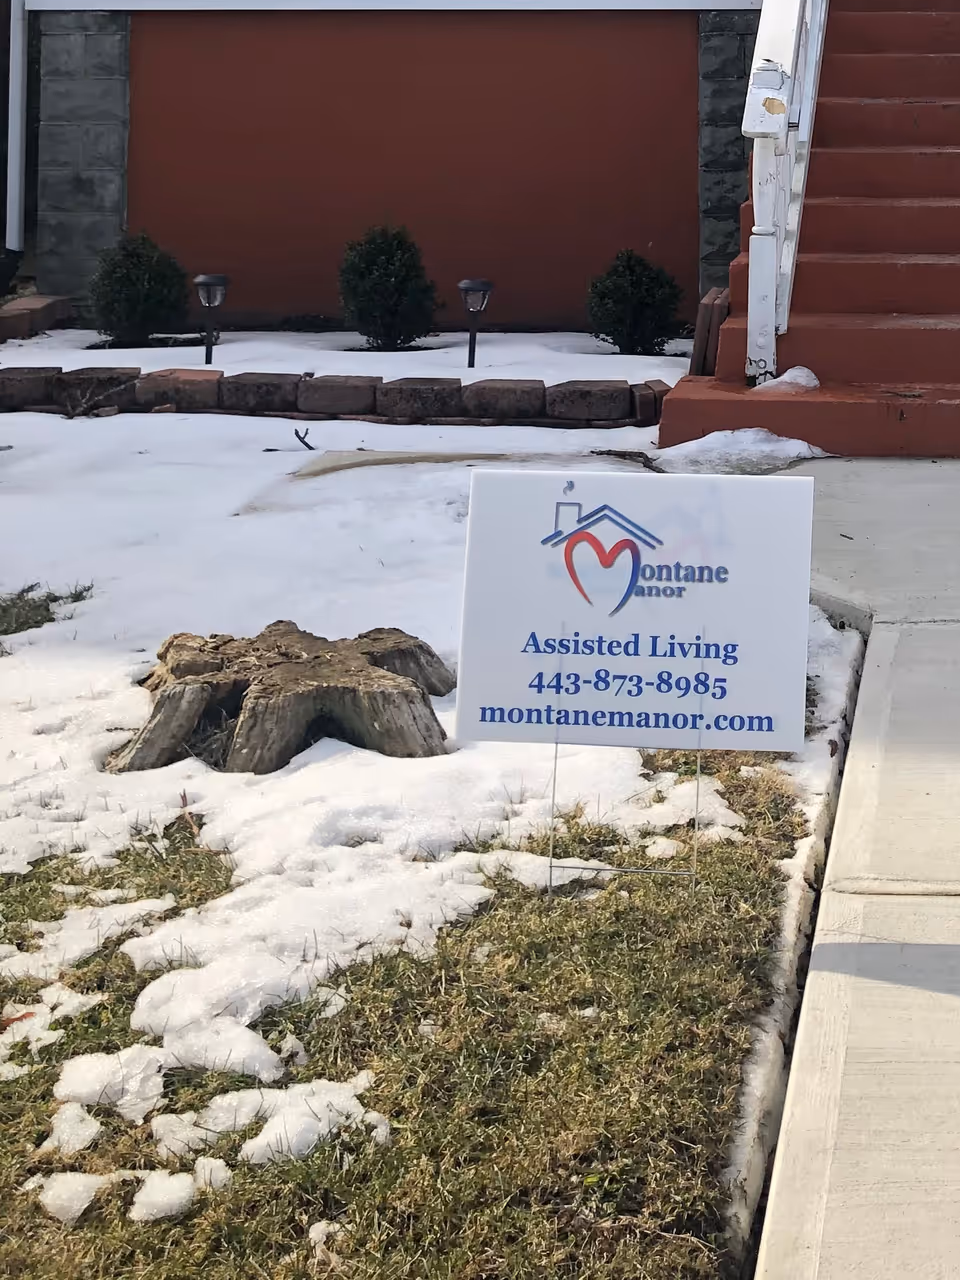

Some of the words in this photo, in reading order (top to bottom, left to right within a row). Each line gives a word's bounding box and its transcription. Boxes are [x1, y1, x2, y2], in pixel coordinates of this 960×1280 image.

[520, 631, 641, 657] Assisted
[648, 634, 739, 665] Living
[527, 668, 728, 700] 443-873-8985
[478, 703, 775, 733] montanemanor.com
